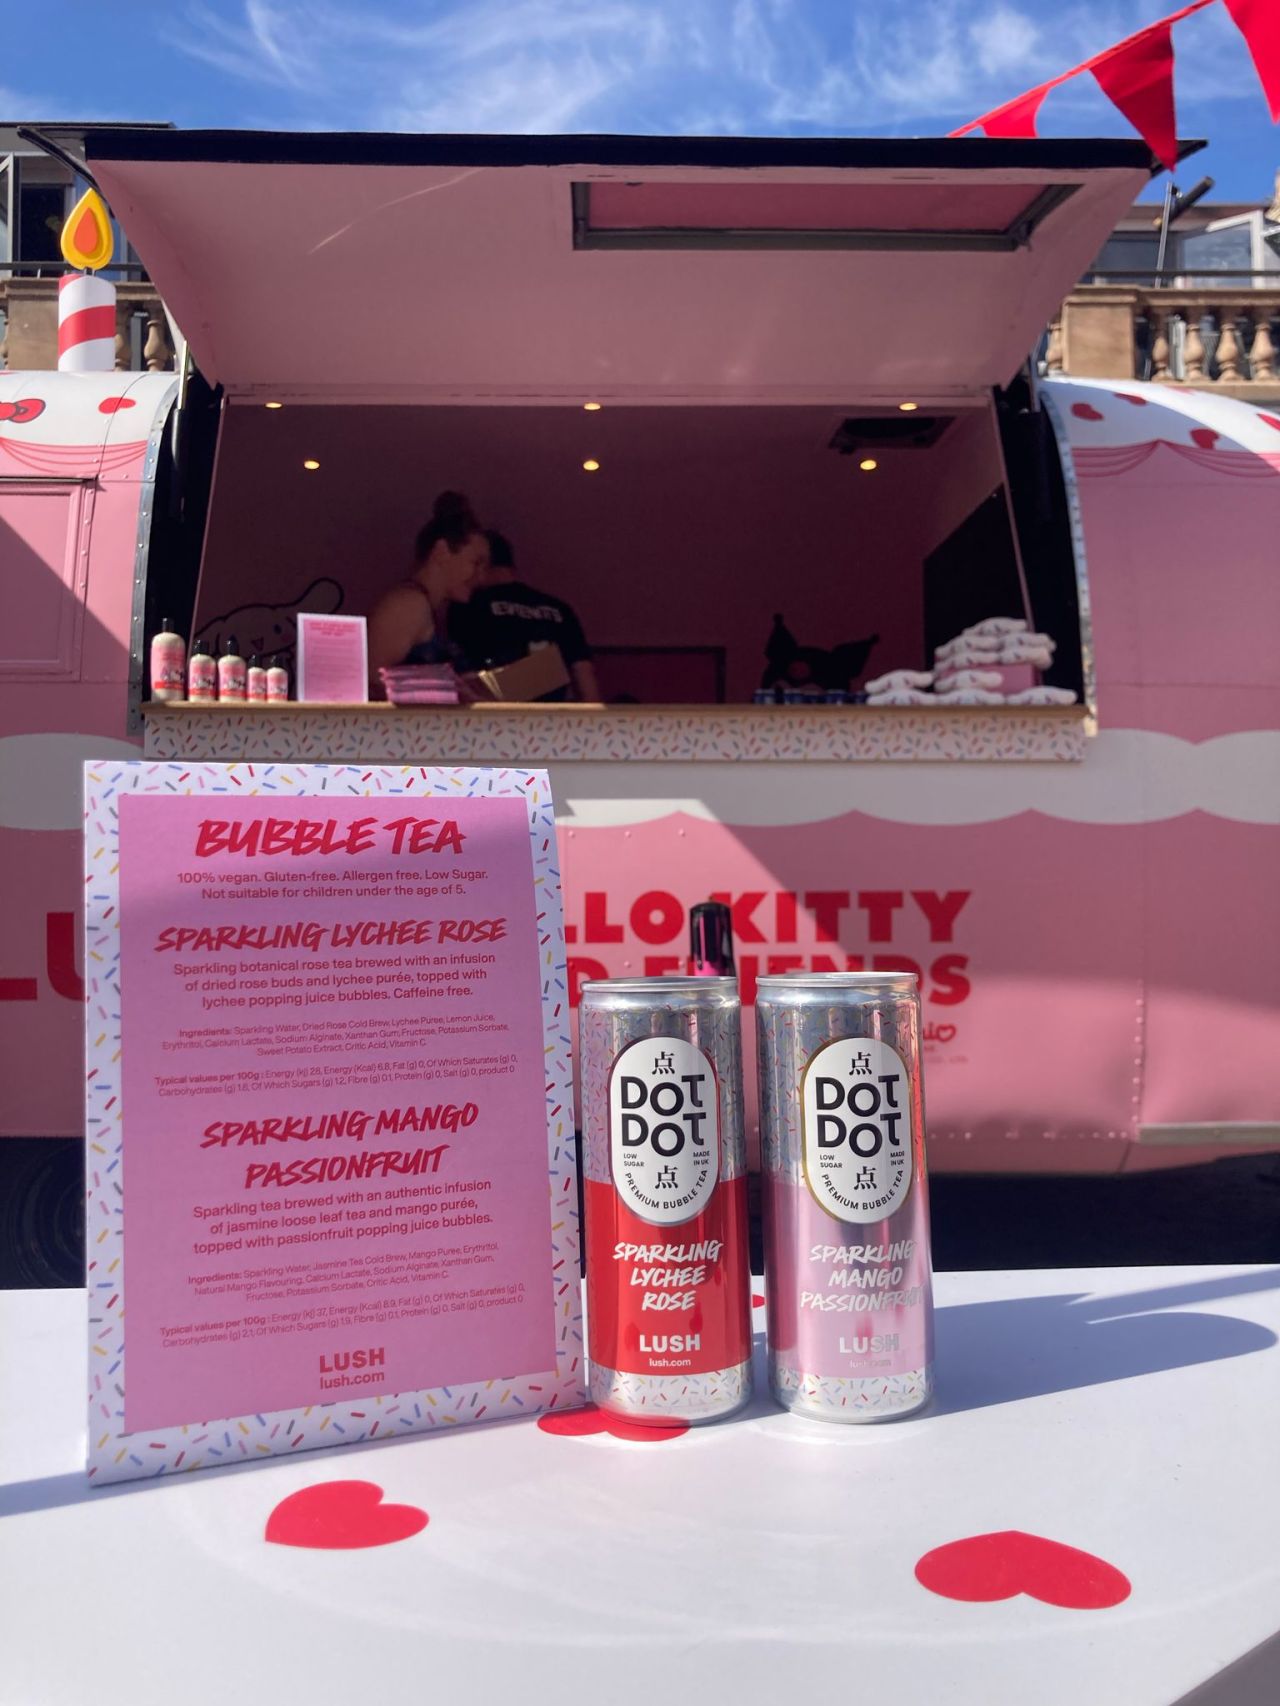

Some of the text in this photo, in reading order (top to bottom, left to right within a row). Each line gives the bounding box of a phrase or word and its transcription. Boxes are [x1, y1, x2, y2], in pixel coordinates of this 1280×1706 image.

[195, 816, 467, 858] BUBBLE TEA
[179, 869, 488, 885] 100% vegan. Gluten-free. Allergen free. Low Sugar.
[201, 884, 466, 900] Not suitable for children under the age of 5.
[154, 917, 508, 952] SPARKLING LYCHEE ROSE
[174, 953, 495, 978] Sparkling botanical rose tea brewed with an infusion
[187, 969, 487, 991] of dried rose buds and lychee purée, topped with
[204, 986, 473, 1010] lychee popping juice bubbles. Caffeine free.
[652, 1051, 675, 1075] 点
[849, 1051, 872, 1075] 点
[620, 1074, 706, 1116] DOT
[815, 1074, 900, 1117] DOT
[200, 1102, 479, 1149] SPARKLING MANGO
[621, 1111, 707, 1157] DOT
[816, 1111, 902, 1158] DOT
[623, 1152, 638, 1160] LOW
[623, 1160, 645, 1168] SUGAR
[692, 1150, 711, 1158] MADE
[693, 1158, 710, 1166] IN UK
[889, 1150, 905, 1158] MADE
[244, 1144, 450, 1190] PASSIONFRUIT
[655, 1165, 679, 1190] 点
[853, 1165, 878, 1190] 点
[194, 1181, 491, 1220] Sparkling tea brewed with an authentic infusion
[625, 1169, 708, 1210] PREMIUM BUBBLE TEA
[821, 1169, 904, 1210] PREMIUM BUBBLE TEA
[210, 1198, 478, 1236] of jasmine loose leaf tea and mango purée,
[194, 1214, 493, 1255] topped with passionfruit popping juice bubbles.
[612, 1240, 724, 1264] SPARKLING
[808, 1239, 917, 1264] SPARKLING
[630, 1264, 707, 1288] LYCHEE
[827, 1266, 904, 1289] MANGO
[641, 1289, 697, 1312] ROSE
[639, 1333, 701, 1353] LUSH
[839, 1333, 900, 1354] LUSH
[319, 1347, 385, 1373] LUSH
[648, 1358, 692, 1367] lush.com
[319, 1370, 385, 1390] lush.com
